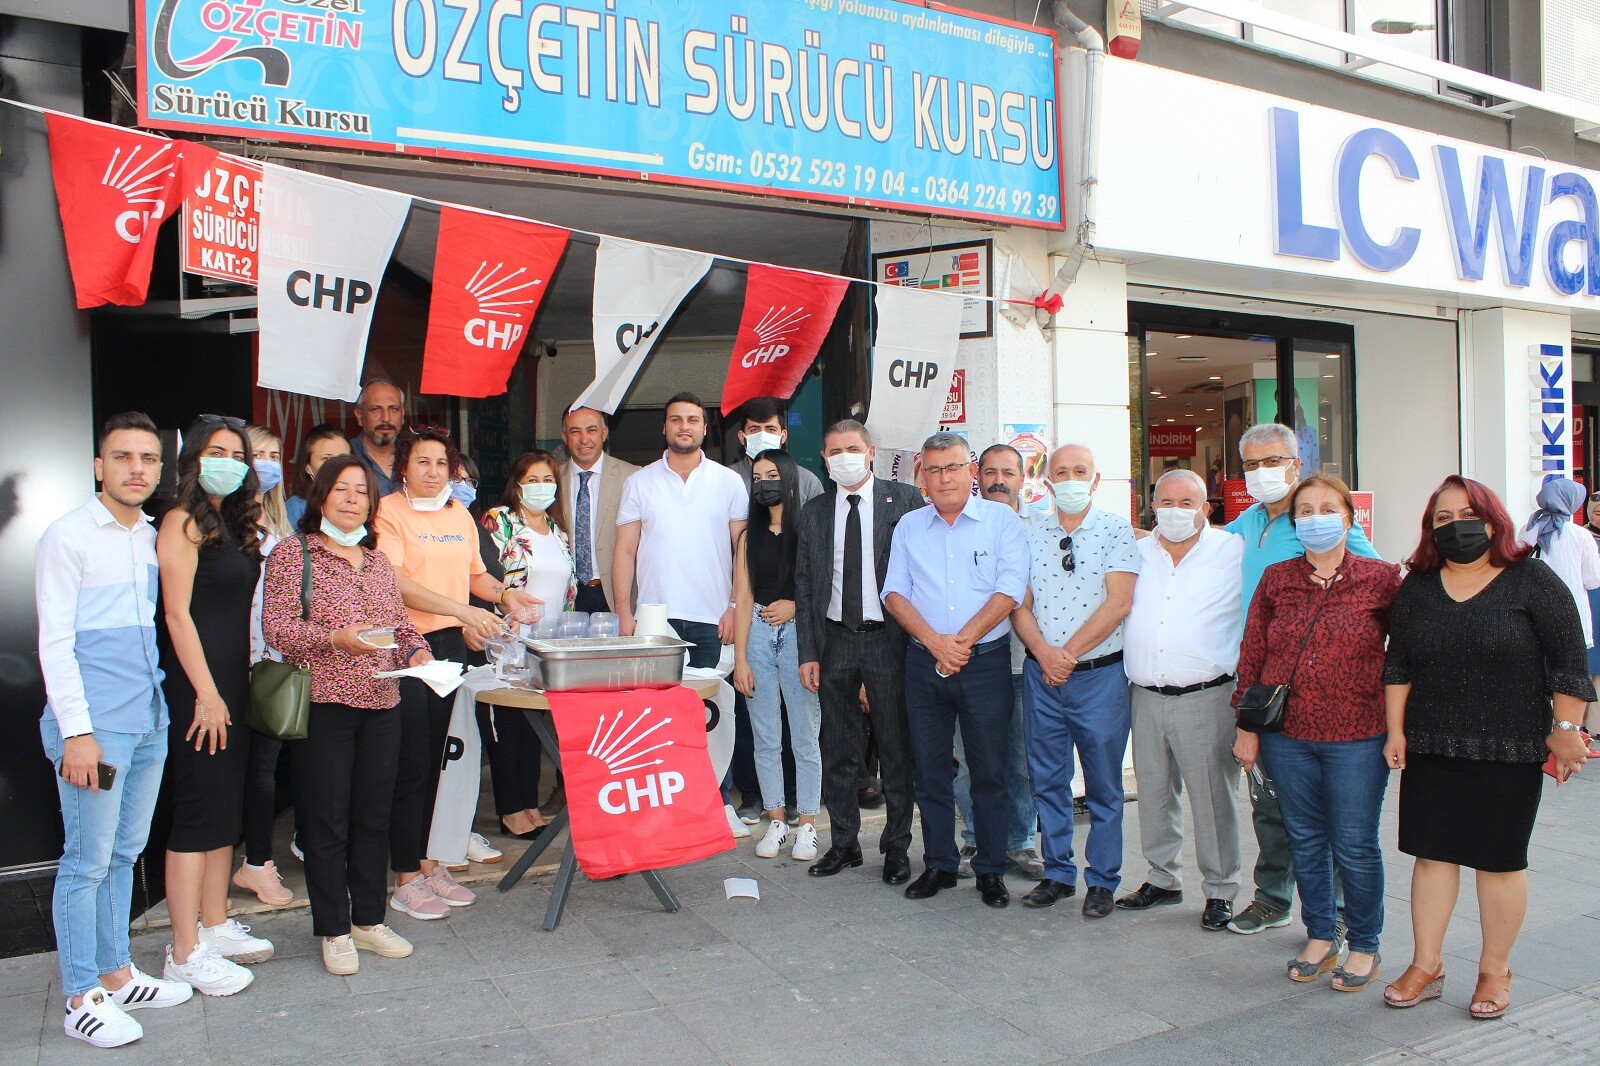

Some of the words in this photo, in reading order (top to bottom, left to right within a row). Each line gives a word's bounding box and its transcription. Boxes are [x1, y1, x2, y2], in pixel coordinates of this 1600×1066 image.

[837, 0, 898, 23] yolunuzu
[902, 13, 981, 42] aydınlatması
[985, 29, 1035, 56] dileğiyle
[154, 85, 268, 123] Sürücü
[278, 98, 370, 133] Kursu
[683, 14, 893, 143] SÜRÜCÜ
[911, 72, 1055, 171] KURSU
[688, 142, 743, 175] Gsm:
[750, 150, 803, 183] 0532
[808, 159, 846, 188] 523
[854, 165, 876, 193] 19
[881, 169, 905, 197] 04
[925, 176, 969, 206] 0364
[974, 184, 1007, 211] 224
[1011, 189, 1031, 215] 92
[1036, 194, 1057, 219] 39
[1268, 106, 1422, 273] LC
[192, 205, 258, 252] SÜRÜCÜ
[201, 247, 252, 277] KAT:2
[286, 269, 374, 314] CHP
[463, 317, 523, 351] CHP
[741, 344, 790, 369] CHP
[888, 359, 939, 389] CHP
[1149, 432, 1192, 445] İNDİRİM
[891, 454, 901, 477] HALK
[430, 533, 466, 543] hummel
[597, 771, 685, 815] CHP
